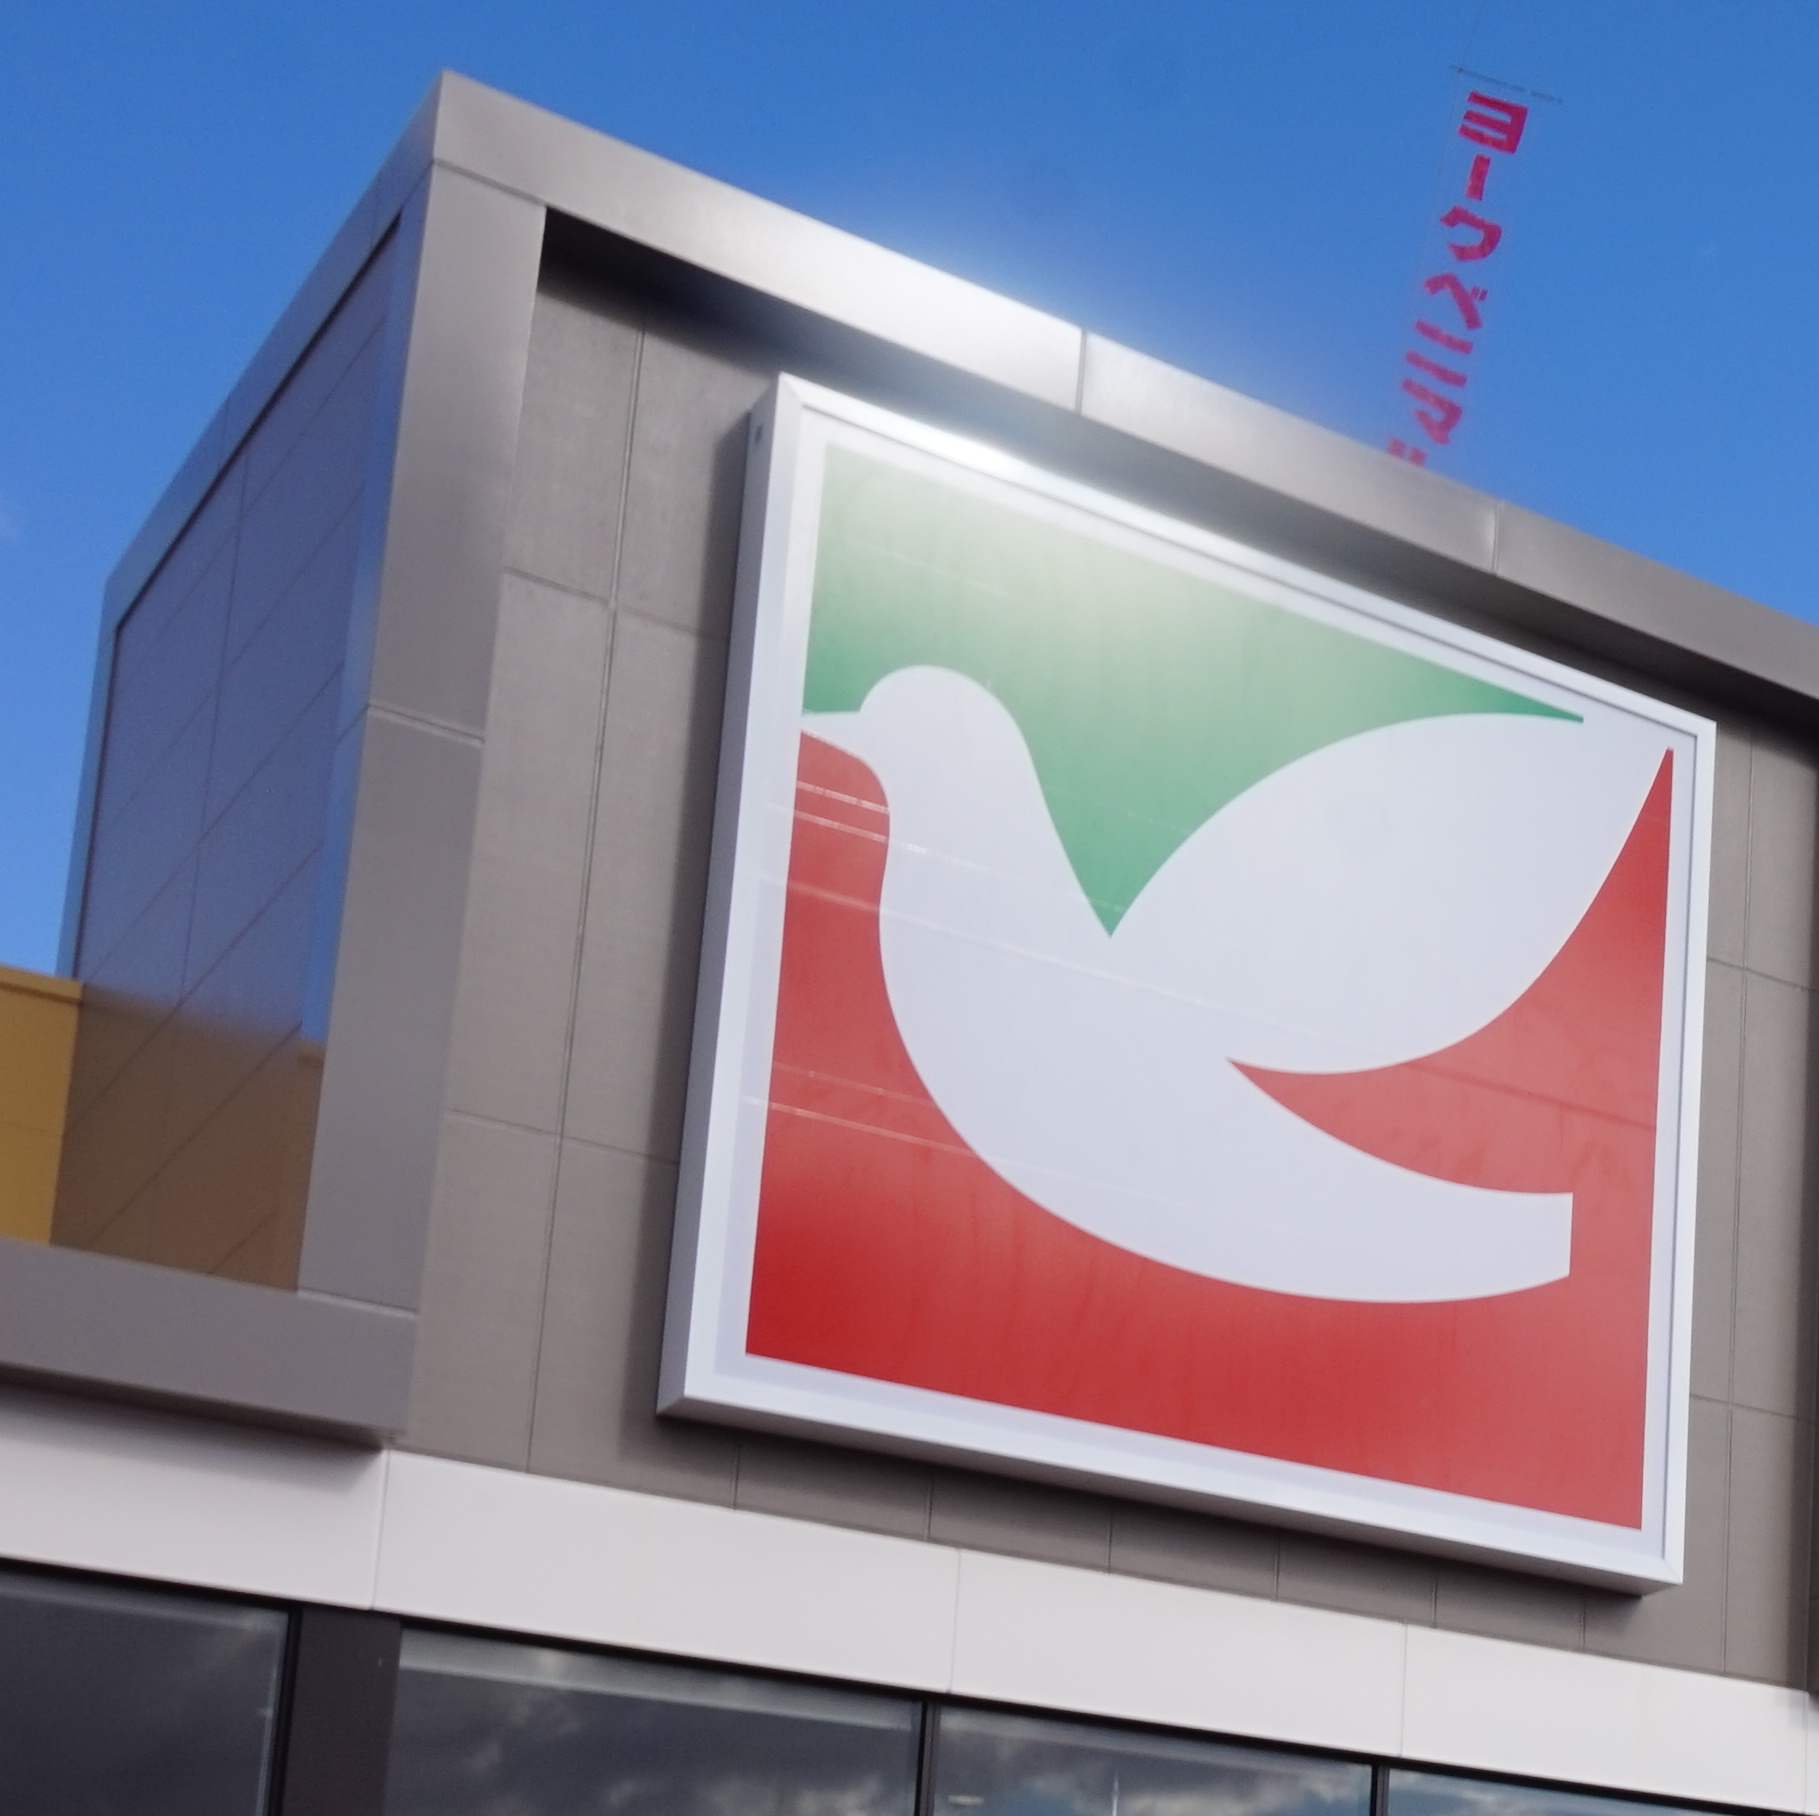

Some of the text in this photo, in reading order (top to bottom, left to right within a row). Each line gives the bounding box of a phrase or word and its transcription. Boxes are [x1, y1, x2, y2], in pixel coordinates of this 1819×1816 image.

[1387, 90, 1528, 466] ヨークベニマ
